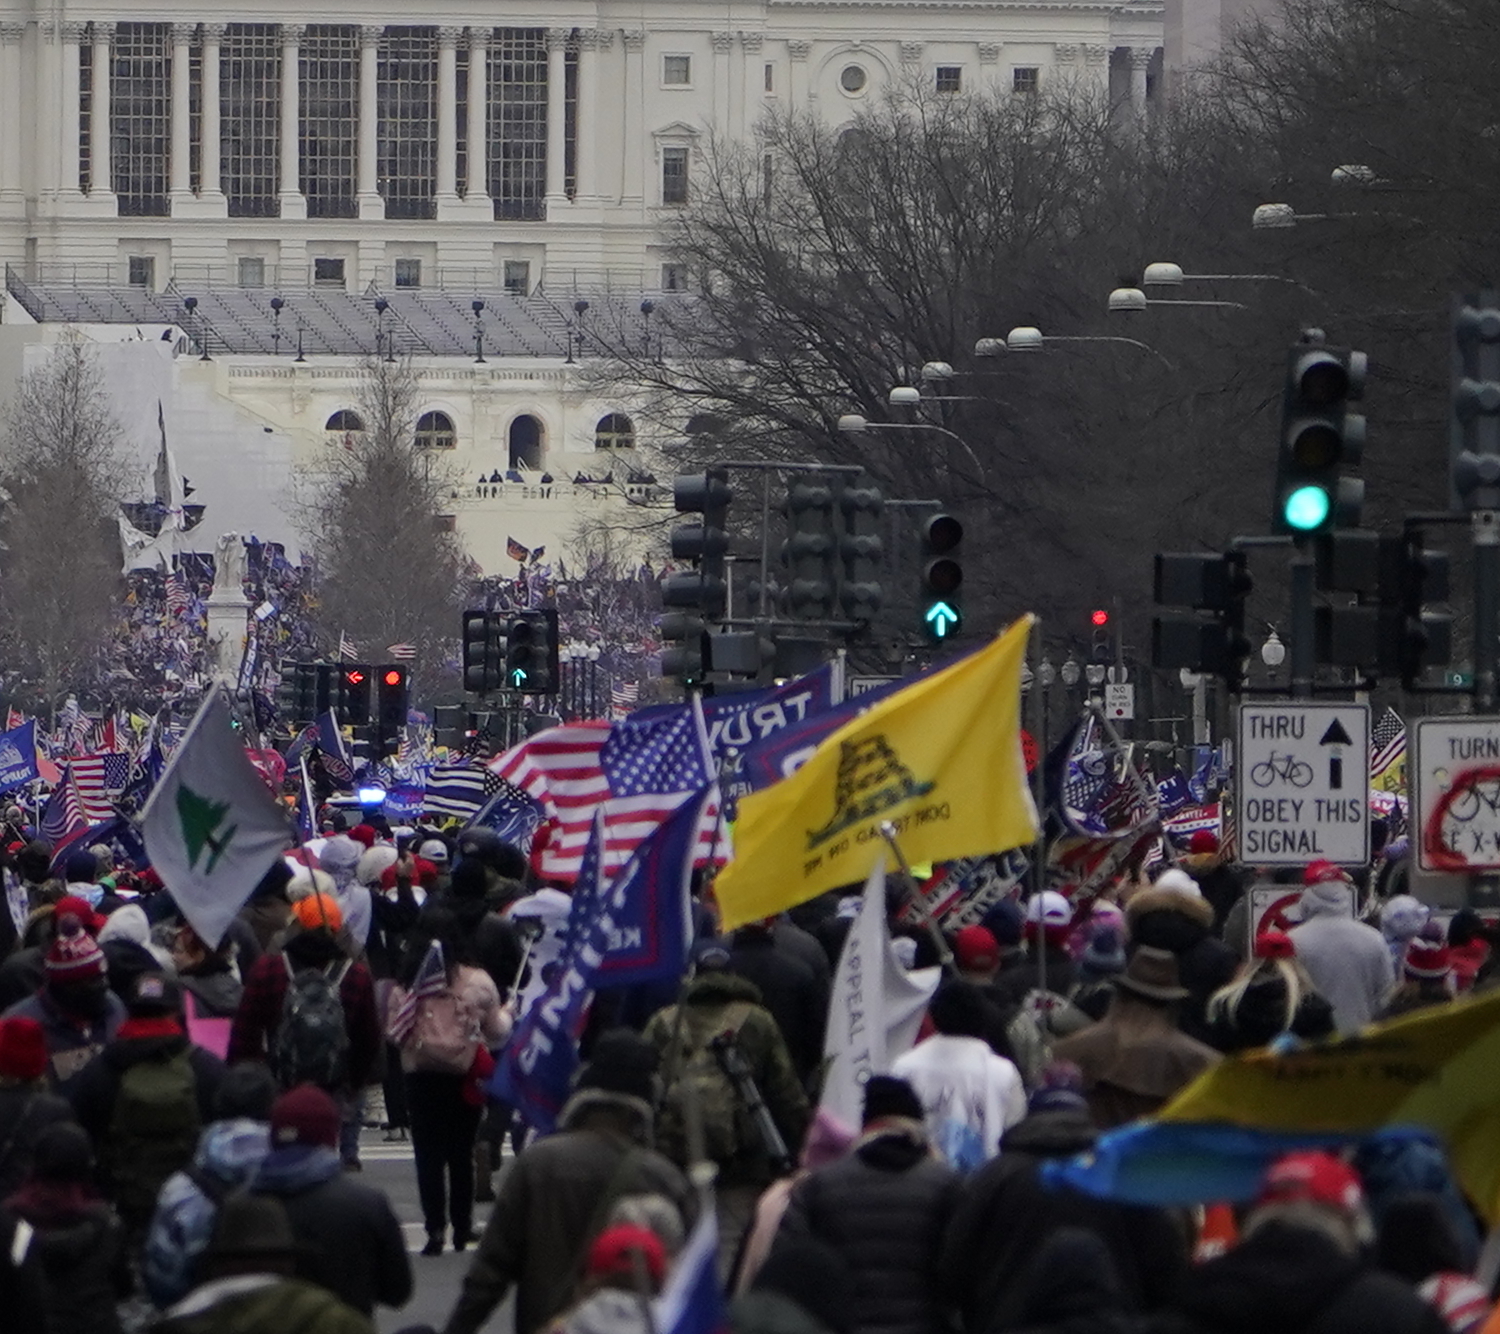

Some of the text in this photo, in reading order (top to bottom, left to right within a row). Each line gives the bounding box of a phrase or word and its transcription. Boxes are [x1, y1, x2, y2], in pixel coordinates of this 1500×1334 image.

[1452, 674, 1463, 685] 9
[1249, 715, 1305, 740] THRU
[1246, 799, 1361, 824] OBEY THIS
[1246, 830, 1323, 854] SIGNAL
